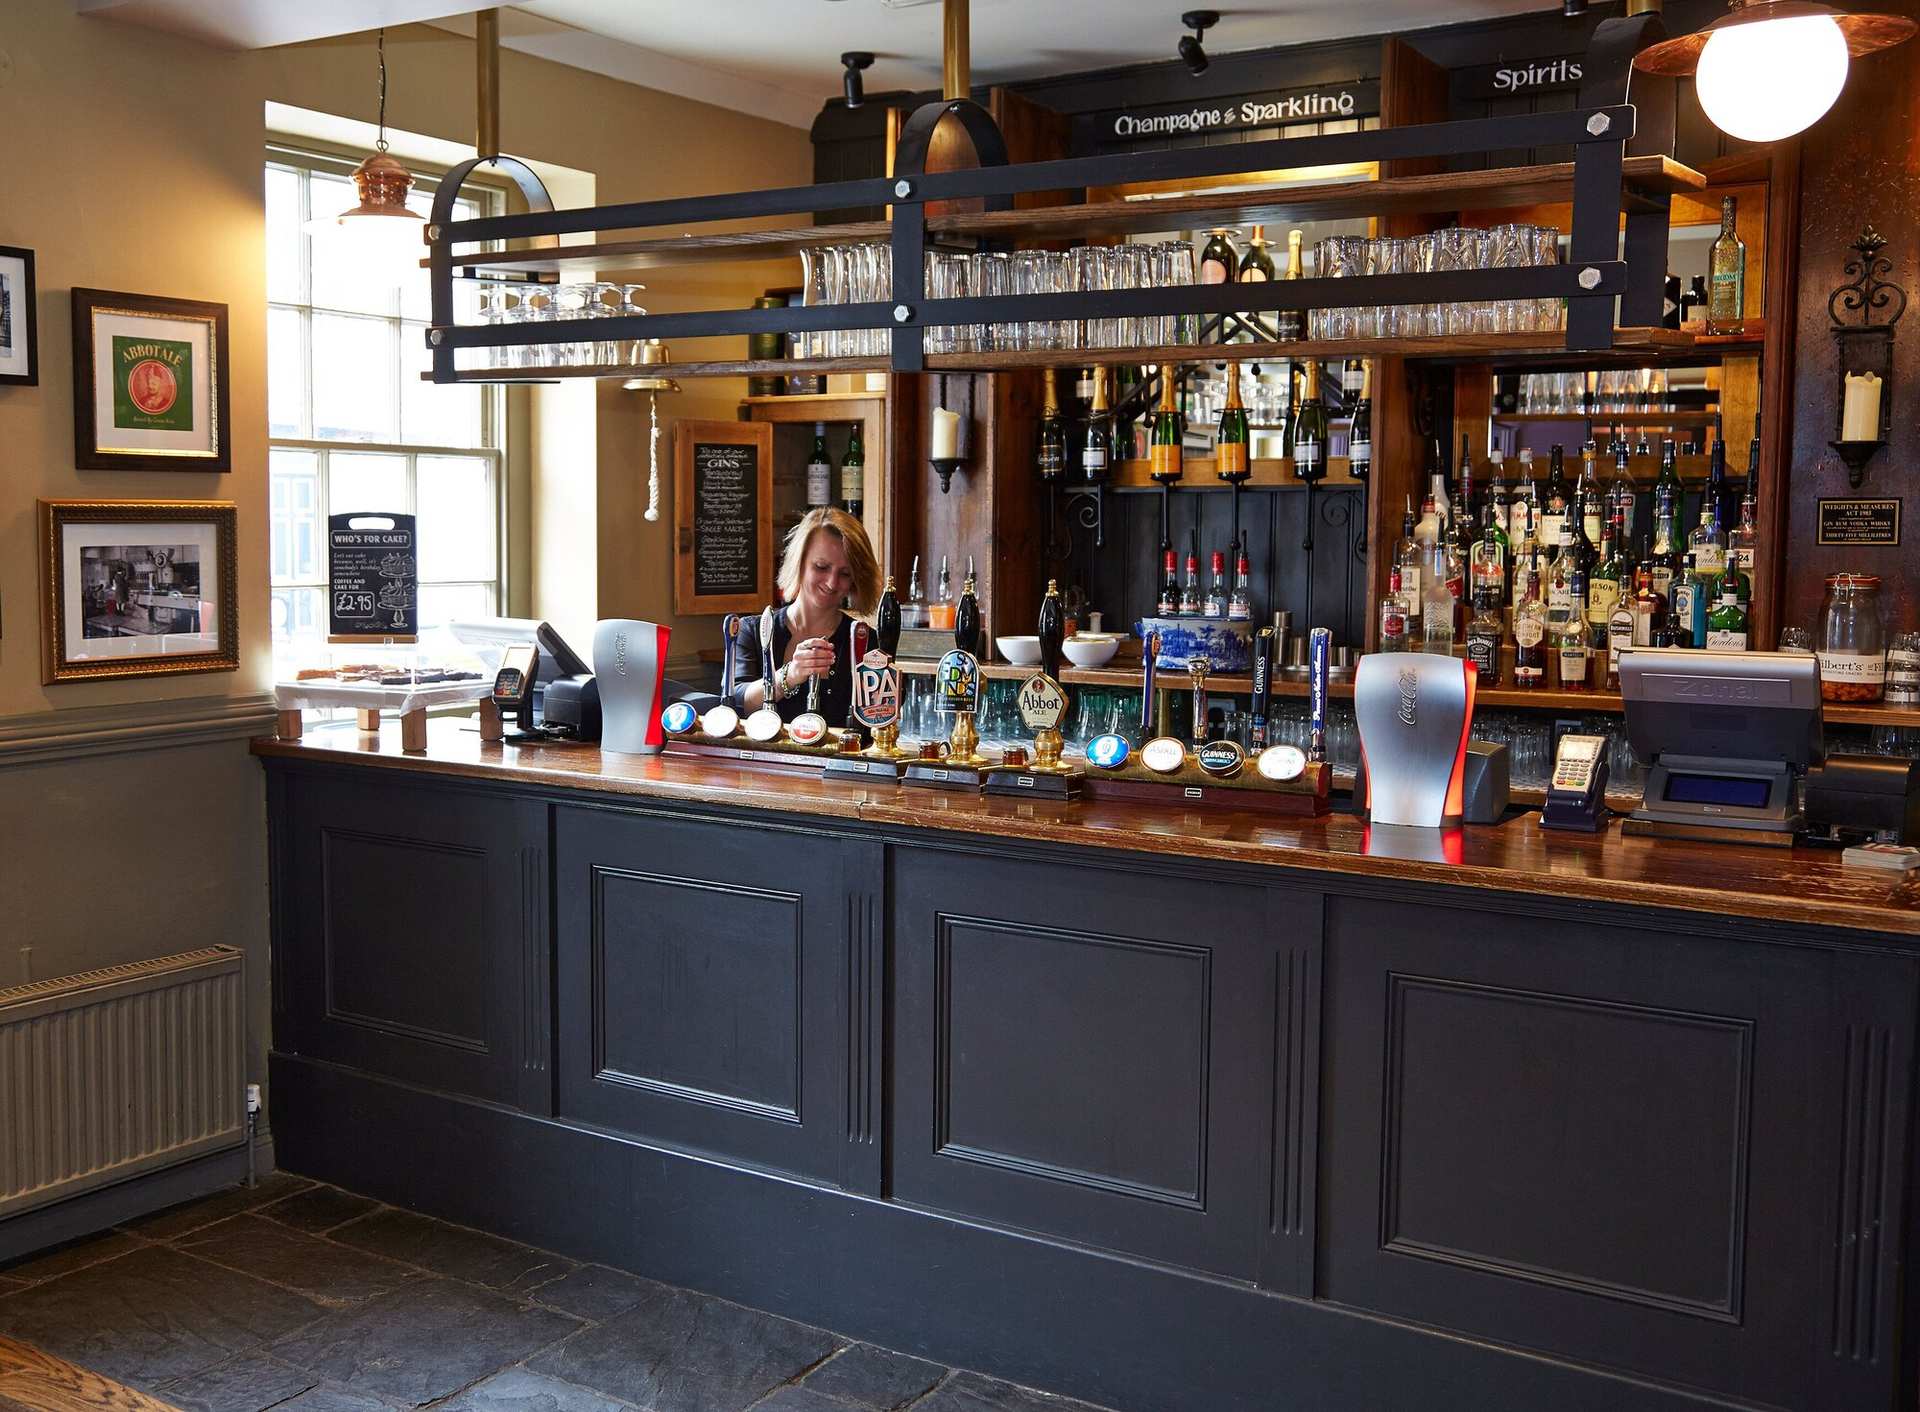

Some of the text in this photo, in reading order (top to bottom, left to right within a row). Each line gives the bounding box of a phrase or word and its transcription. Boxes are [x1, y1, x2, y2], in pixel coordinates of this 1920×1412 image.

[1493, 59, 1584, 92] Spirits
[1114, 108, 1221, 136] Champagne
[1240, 91, 1354, 125] Sparkling
[122, 344, 183, 368] ABBOT ALE
[707, 459, 740, 468] GINS
[334, 534, 408, 544] WHO'S FOR CAKE?
[1254, 656, 1266, 694] GUINNESS
[1820, 660, 1863, 672] ilbert's
[856, 668, 897, 706] IPA
[1022, 690, 1060, 711] Abbot
[1201, 749, 1236, 760] GUINNESS
